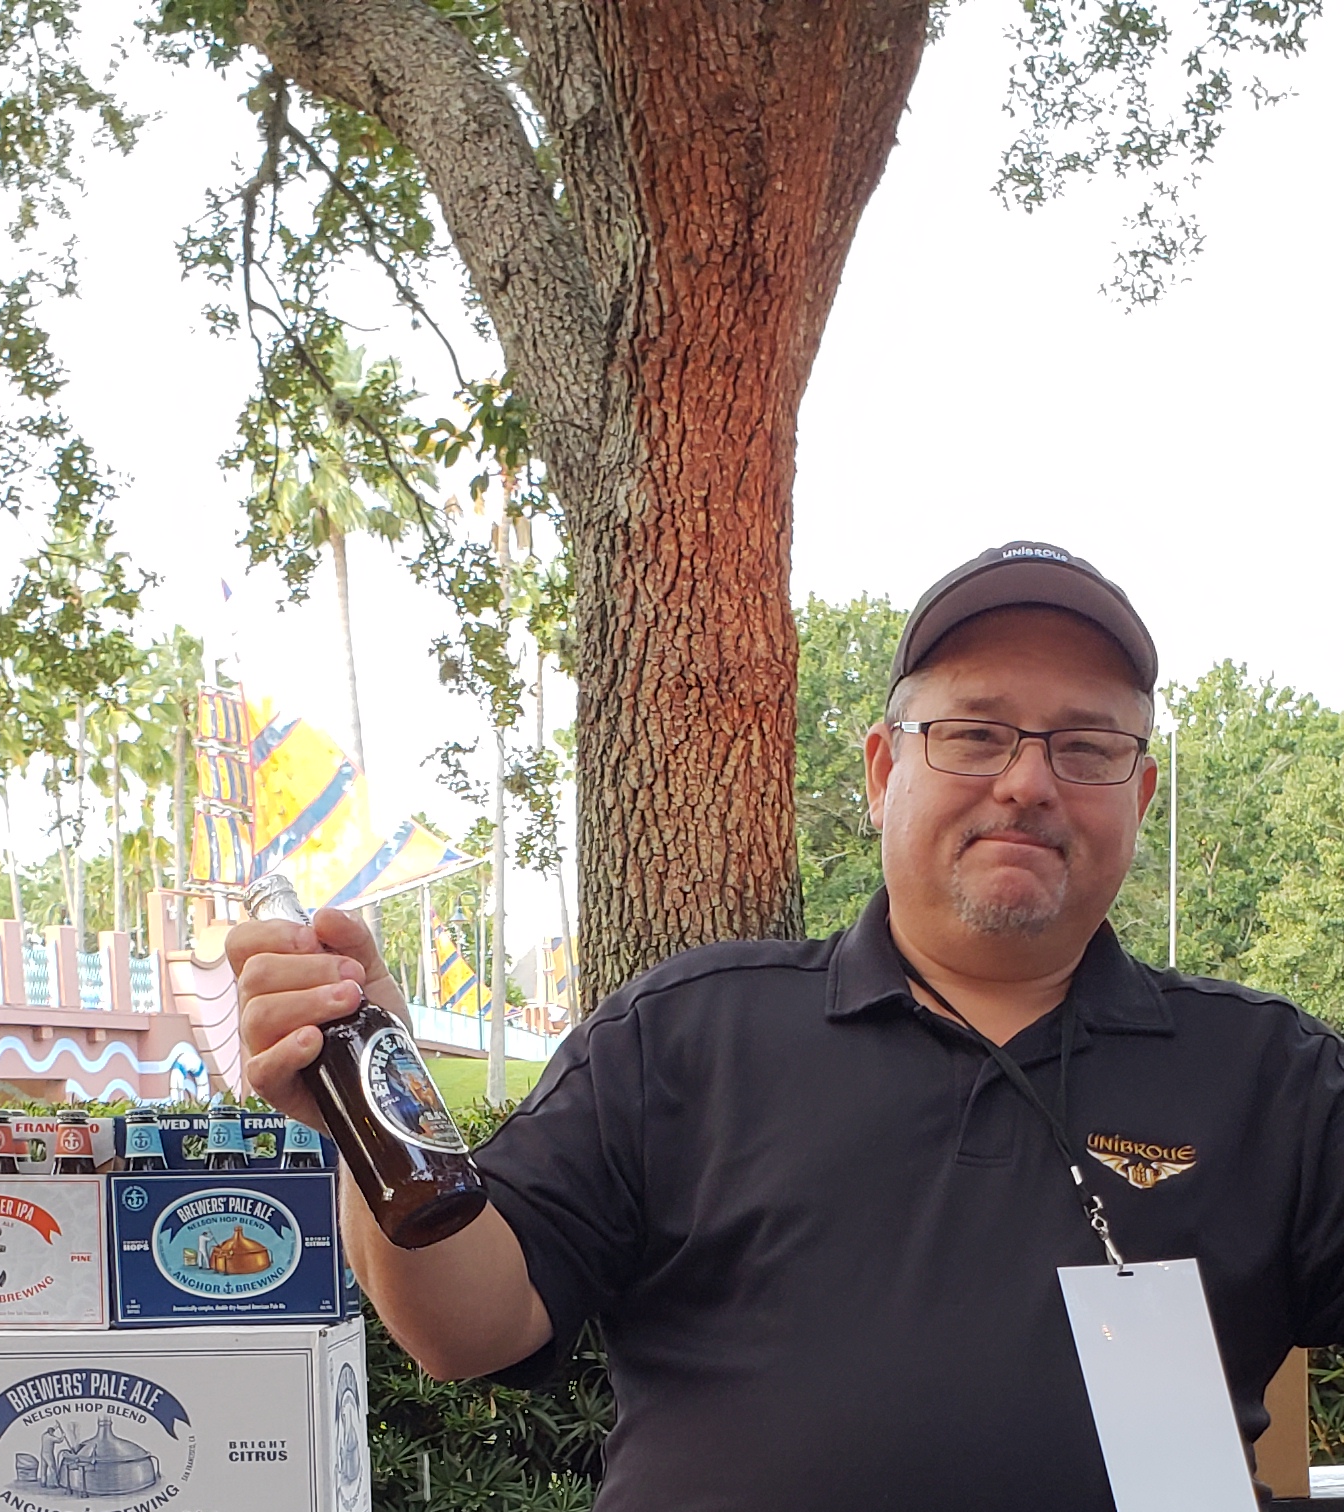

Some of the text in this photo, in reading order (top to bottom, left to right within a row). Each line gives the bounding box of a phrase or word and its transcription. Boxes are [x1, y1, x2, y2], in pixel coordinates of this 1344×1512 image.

[1086, 1133, 1197, 1161] UNIBROUE
[15, 1202, 35, 1221] IPA
[229, 1199, 253, 1214] PALE
[255, 1202, 276, 1222] ALE
[187, 1216, 218, 1231] NELSON
[239, 1217, 265, 1230] BLEND
[173, 1266, 285, 1293] ANCHOR BREWING
[6, 1373, 164, 1412] BREWERS' PALE ALE
[23, 1403, 147, 1427] NELSON HOP BLEND
[229, 1441, 287, 1449] BRIGHT
[229, 1451, 288, 1462] CITRUS
